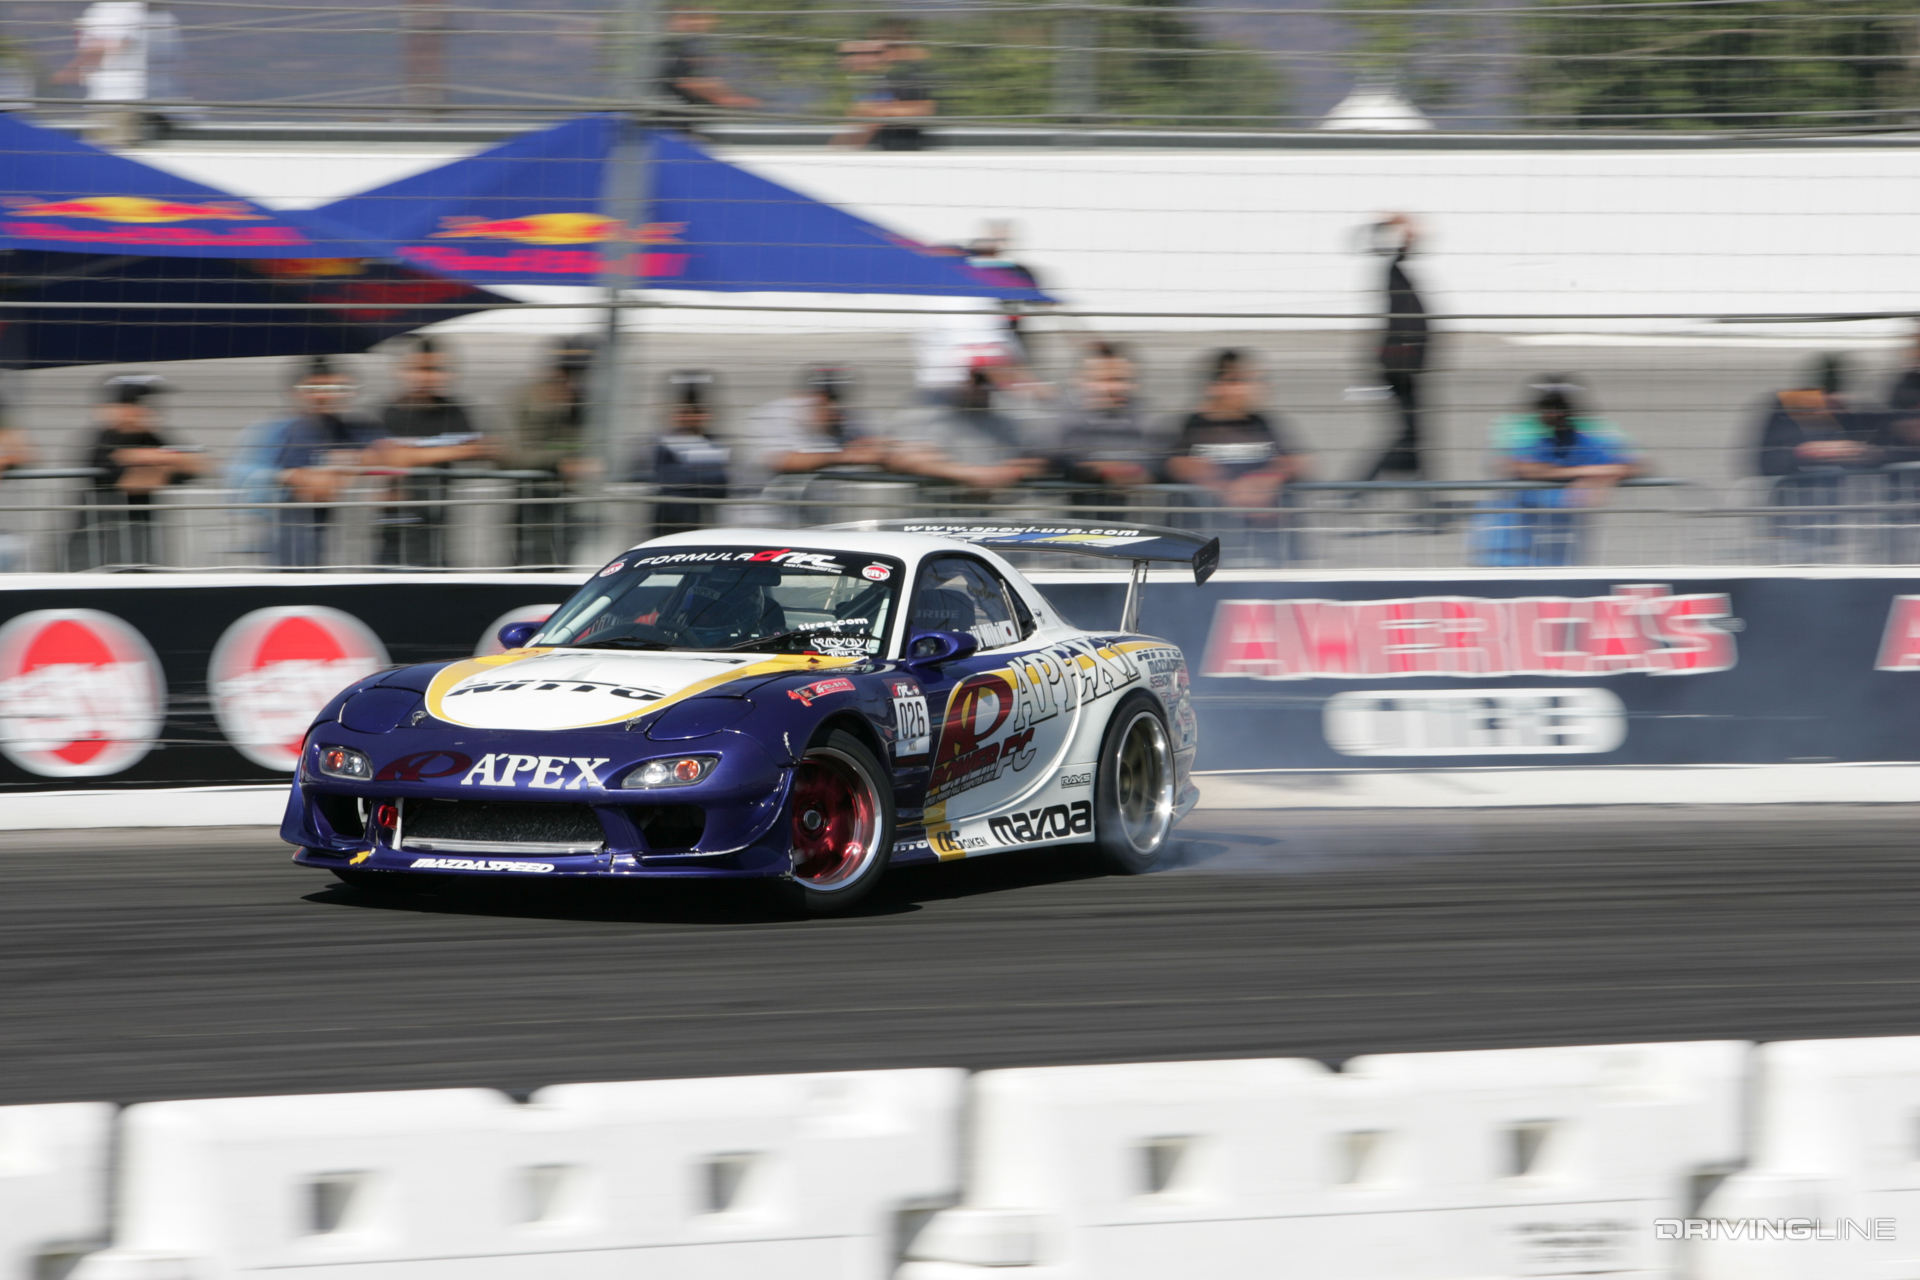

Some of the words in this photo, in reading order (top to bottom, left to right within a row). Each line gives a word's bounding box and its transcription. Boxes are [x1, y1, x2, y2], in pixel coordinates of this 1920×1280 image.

[634, 551, 751, 568] FORMULA
[798, 617, 868, 631] tires.com
[899, 701, 925, 739] 026
[926, 742, 1000, 797] POWER
[994, 727, 1037, 778] FC
[1061, 773, 1091, 786] RAYS
[893, 840, 928, 852] ITTO
[963, 836, 989, 849] GIKEN
[410, 858, 555, 873] MAZDASPEED
